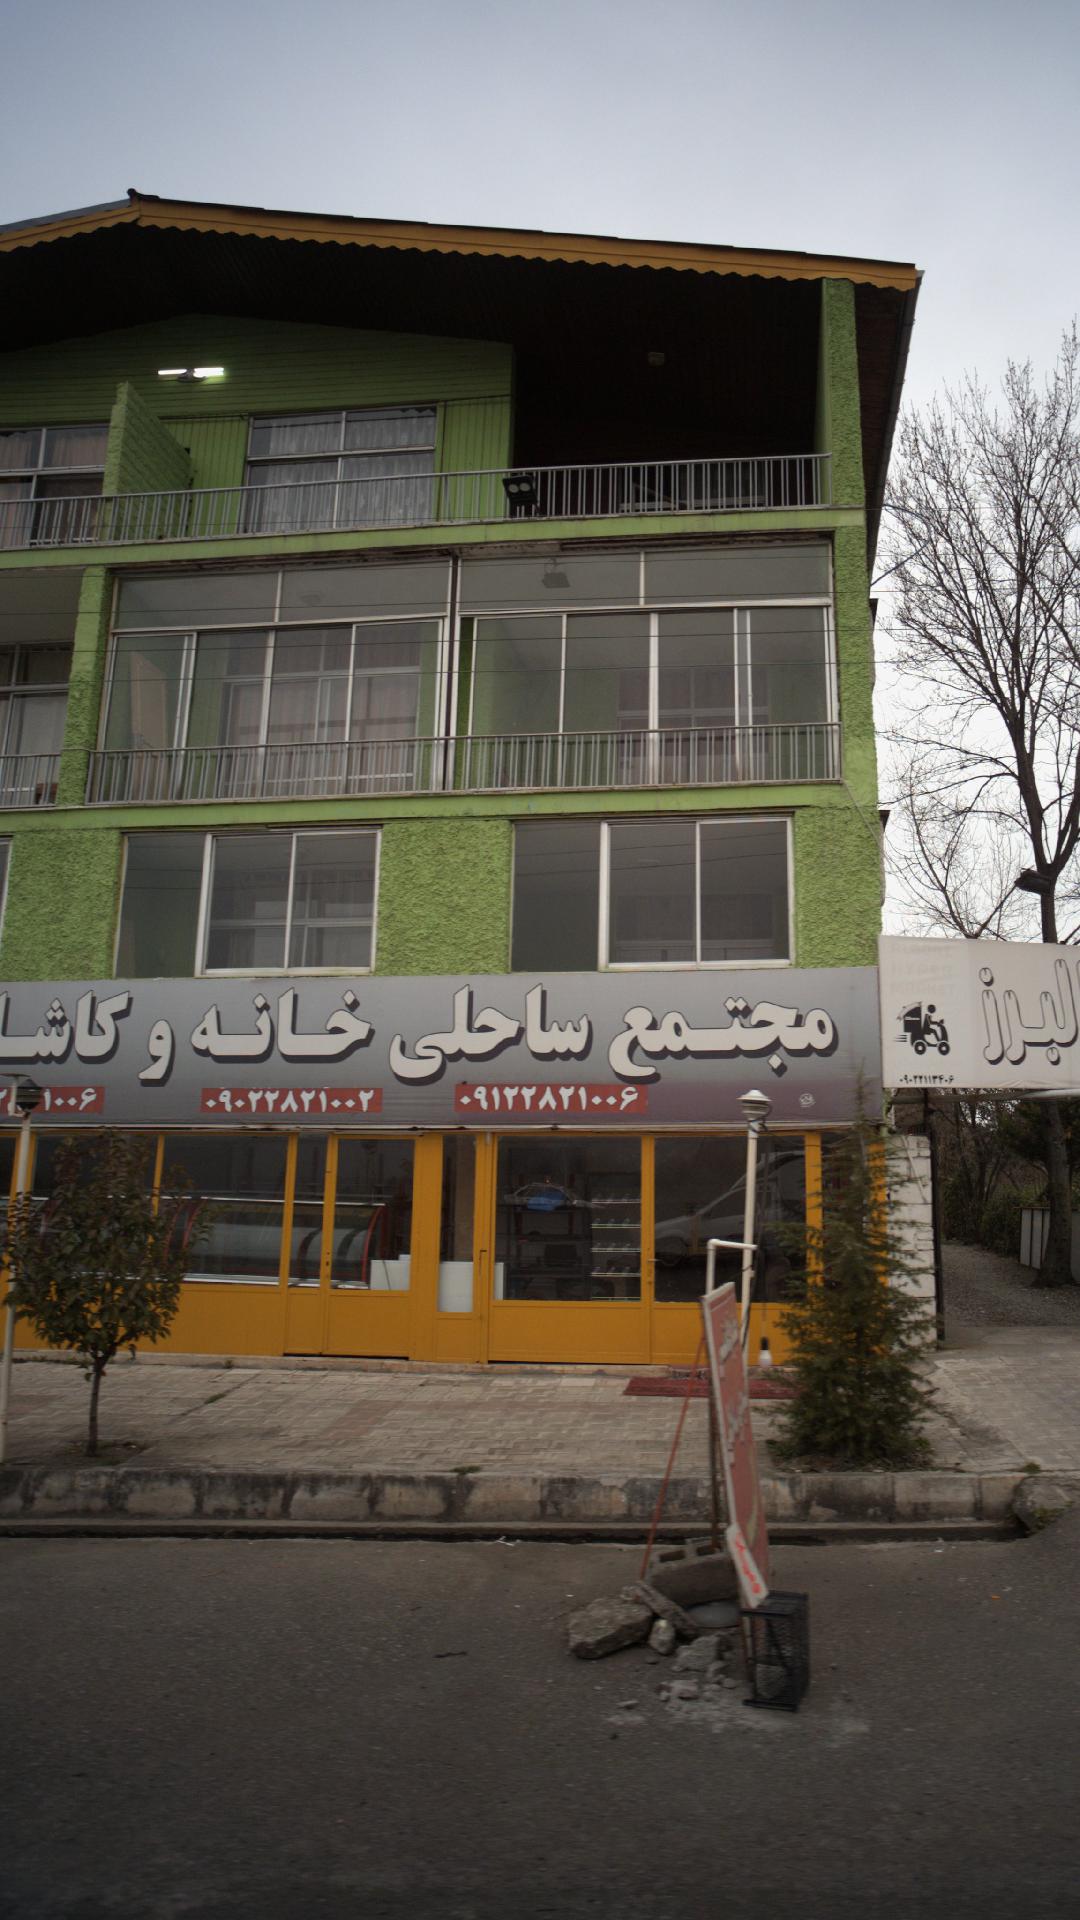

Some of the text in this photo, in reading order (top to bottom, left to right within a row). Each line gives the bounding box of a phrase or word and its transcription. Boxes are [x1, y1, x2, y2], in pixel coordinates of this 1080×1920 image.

[138, 1019, 174, 1081] و
[191, 989, 373, 1060] خانه
[389, 983, 590, 1080] ساحلی
[608, 996, 836, 1079] مجتمع
[205, 1089, 375, 1113] ۰۹۰۲۲۸۲۱۰۰۲
[460, 1085, 639, 1111] ۰۹۱۲۲۸۲۱۰۰۶
